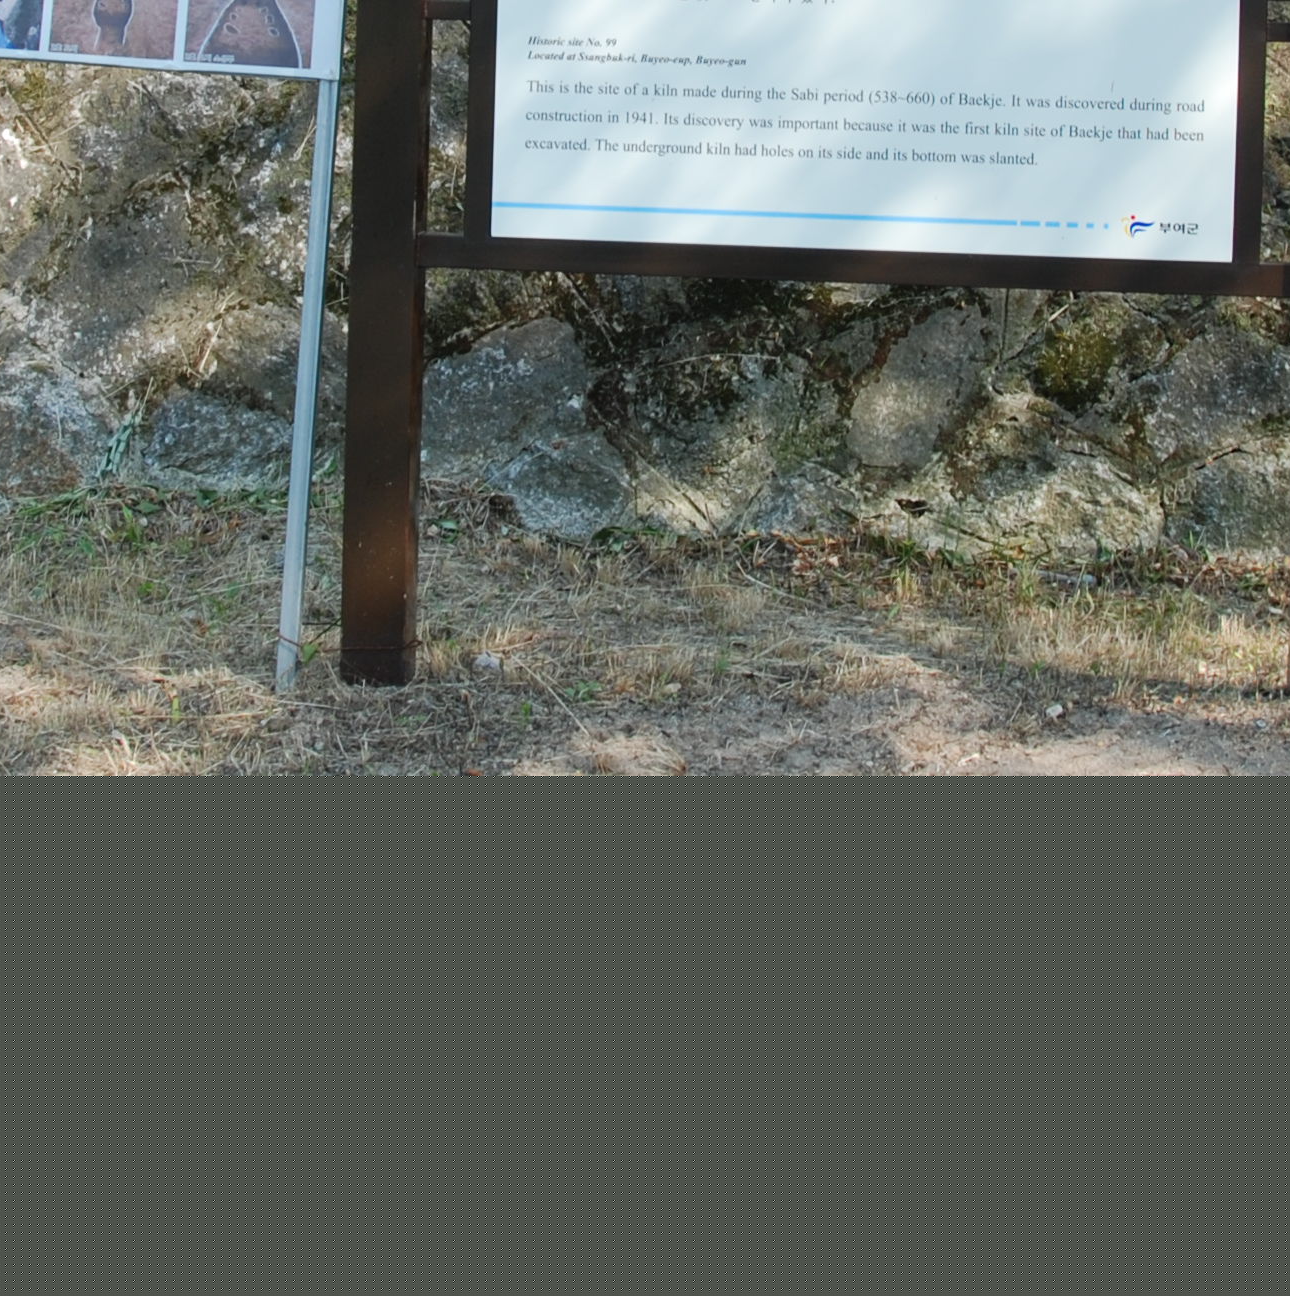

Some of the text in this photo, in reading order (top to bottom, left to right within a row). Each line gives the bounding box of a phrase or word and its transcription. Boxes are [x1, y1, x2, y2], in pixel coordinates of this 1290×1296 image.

[526, 34, 617, 47] Historic site No. 99
[527, 49, 747, 68] Located at Ssangbuk-ri, Buyeo-eup, Buyeo-gun
[526, 79, 555, 93] This
[558, 79, 570, 94] is
[573, 80, 594, 95] the
[597, 81, 620, 95] site
[623, 81, 639, 96] of
[641, 86, 650, 97] a
[652, 82, 678, 98] kiln
[682, 83, 717, 98] made
[720, 85, 763, 103] during
[766, 86, 787, 100] the
[790, 86, 819, 102] Sabi
[822, 87, 864, 106] period
[939, 91, 956, 105] of
[957, 91, 1006, 111] Baekje.
[1011, 93, 1021, 107] It
[1025, 97, 1051, 109] was
[1054, 95, 1125, 111] discovered
[1128, 96, 1172, 115] during
[1176, 98, 1205, 113] road
[524, 107, 1204, 143] construction in 1941. Its discovery was important because it was the first kiln site of Baekje that had been
[524, 135, 1038, 166] excavated. The underground kiln had holes on its side and its bottom was slanted.
[1158, 221, 1199, 235] 부여군
